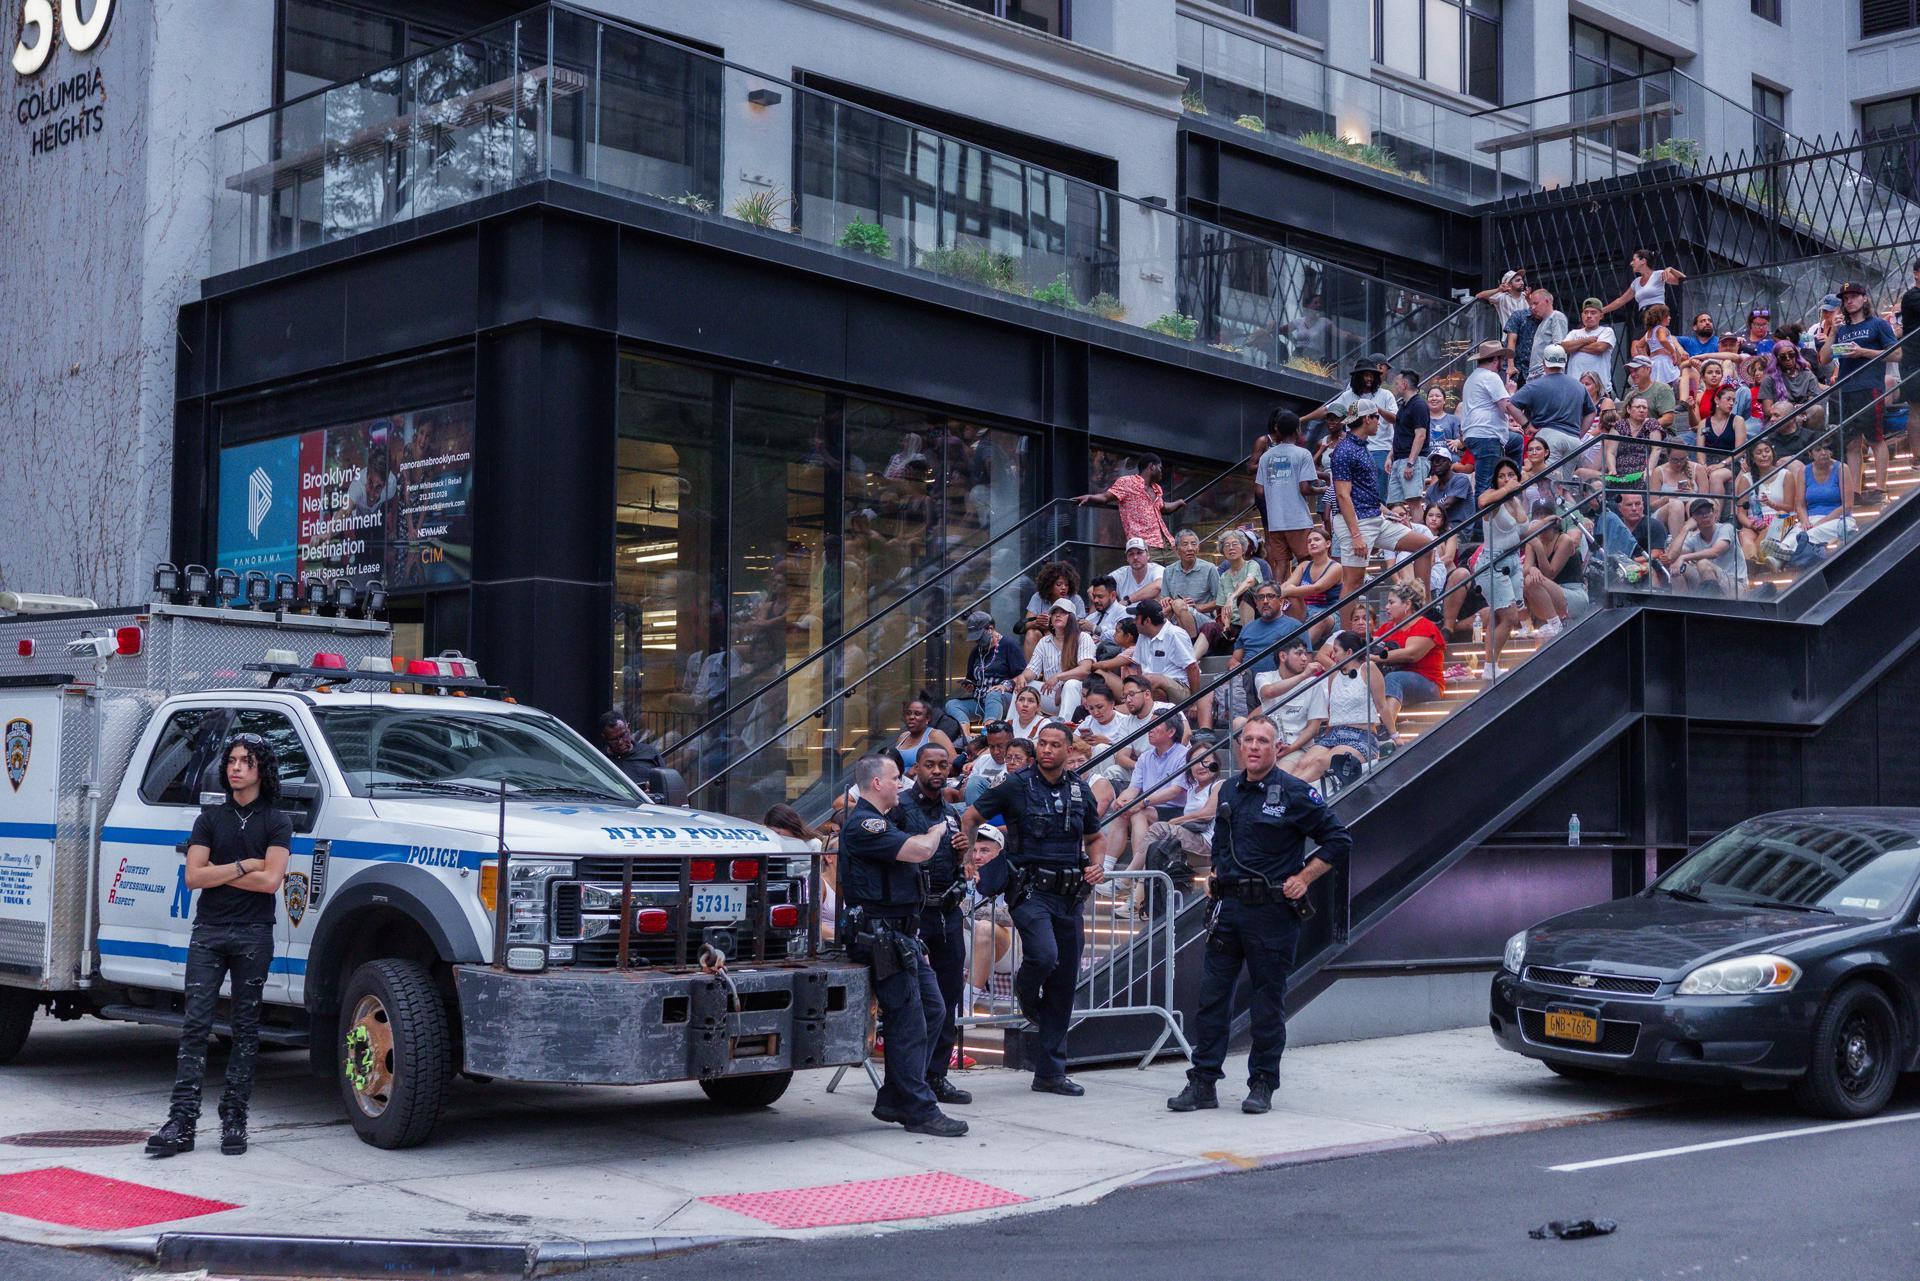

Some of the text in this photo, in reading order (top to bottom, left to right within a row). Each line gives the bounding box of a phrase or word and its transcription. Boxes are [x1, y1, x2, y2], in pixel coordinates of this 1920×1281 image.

[17, 66, 106, 124] COLUMBIA
[32, 105, 104, 157] HEIGHTS
[399, 452, 470, 471] panoramabrooklyn.com
[303, 464, 361, 490] Brooklyn's
[302, 490, 350, 514] Next Big
[302, 509, 382, 537] Entertainment
[417, 525, 448, 538] NEWMARK
[301, 537, 365, 561] Destination
[421, 547, 443, 564] CIM
[234, 553, 281, 567] PANORAMA
[301, 563, 380, 581] Retail Space for Lease
[600, 827, 770, 842] NYPD POLICE
[408, 845, 459, 868] POLICE
[113, 873, 166, 893] PROFESSIONALISM
[696, 894, 743, 913] 5731 17
